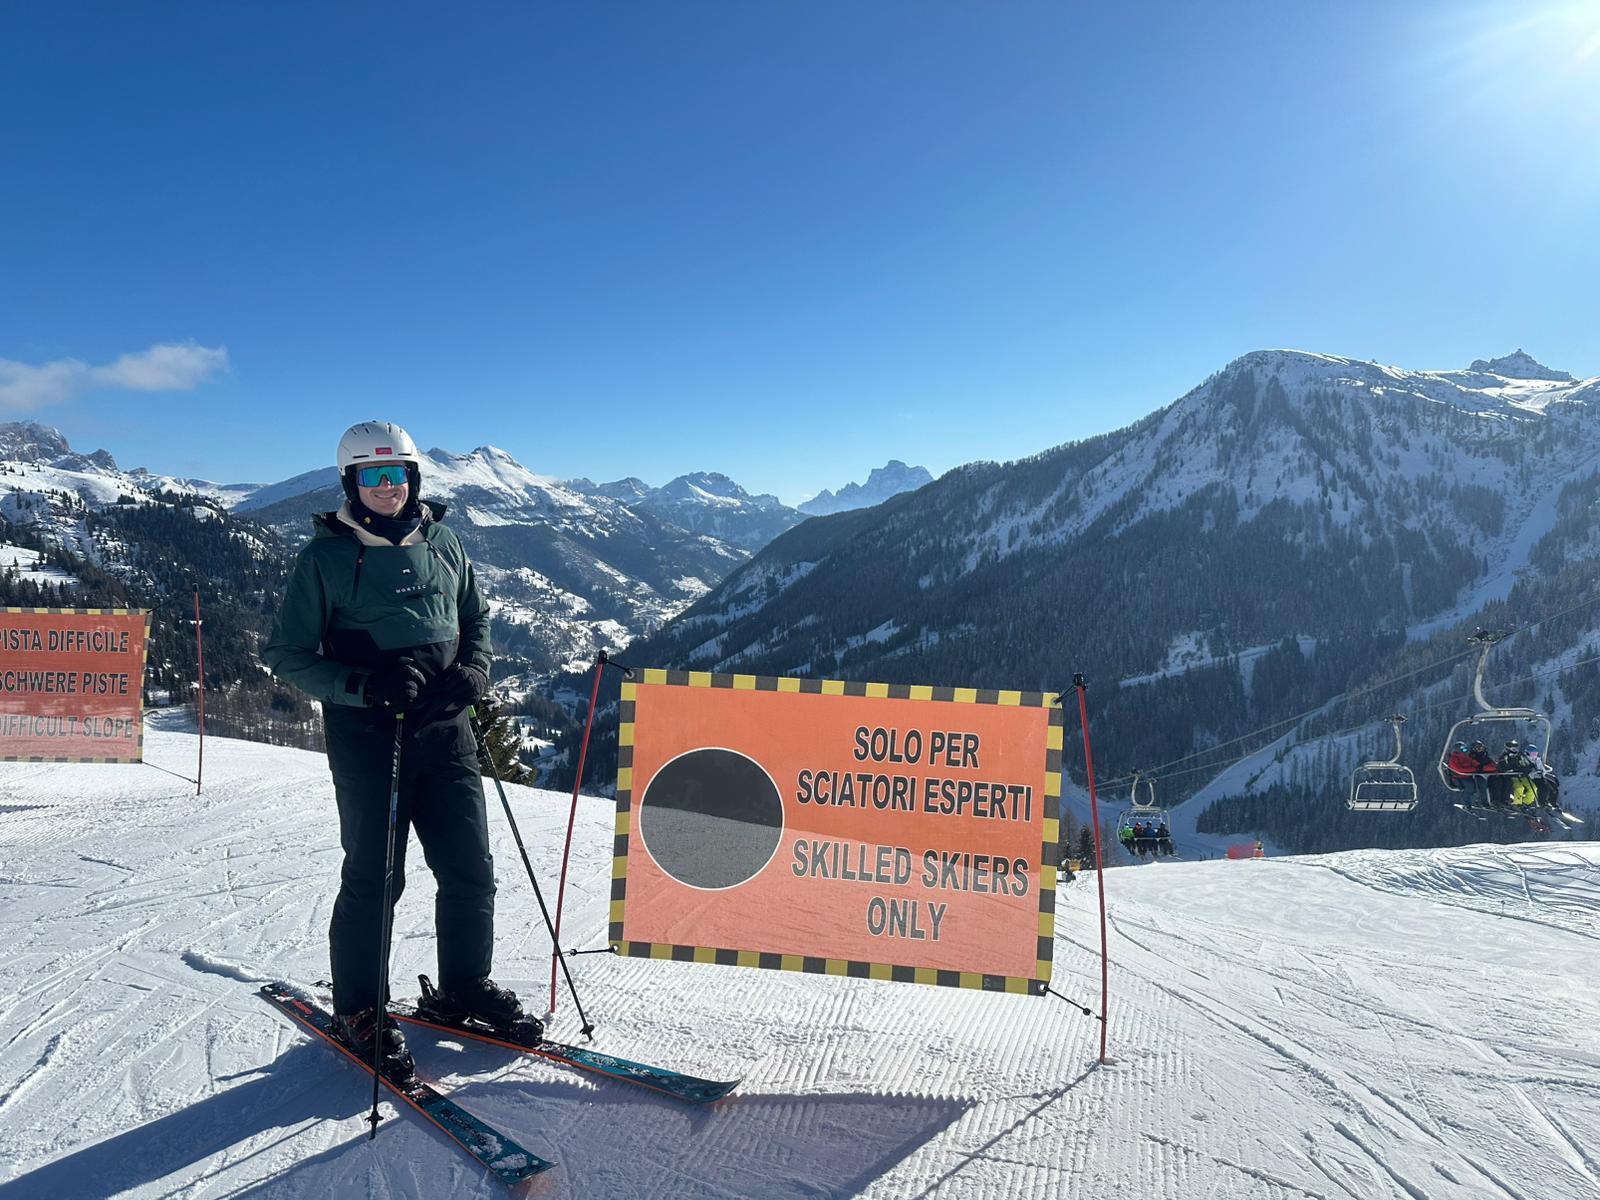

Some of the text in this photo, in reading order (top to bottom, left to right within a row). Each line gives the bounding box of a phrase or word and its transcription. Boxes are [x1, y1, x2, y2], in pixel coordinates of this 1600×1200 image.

[0, 629, 129, 652] ISTA DIFFICILE
[0, 671, 128, 695] CHWERE PISTE
[0, 714, 133, 738] IFFICULT SLOPE
[853, 726, 980, 769] SOLO PER
[796, 769, 1032, 822] SCIATORI ESPERTI
[791, 839, 1029, 897] SKILLED SKIERS
[866, 896, 947, 941] ONLY
